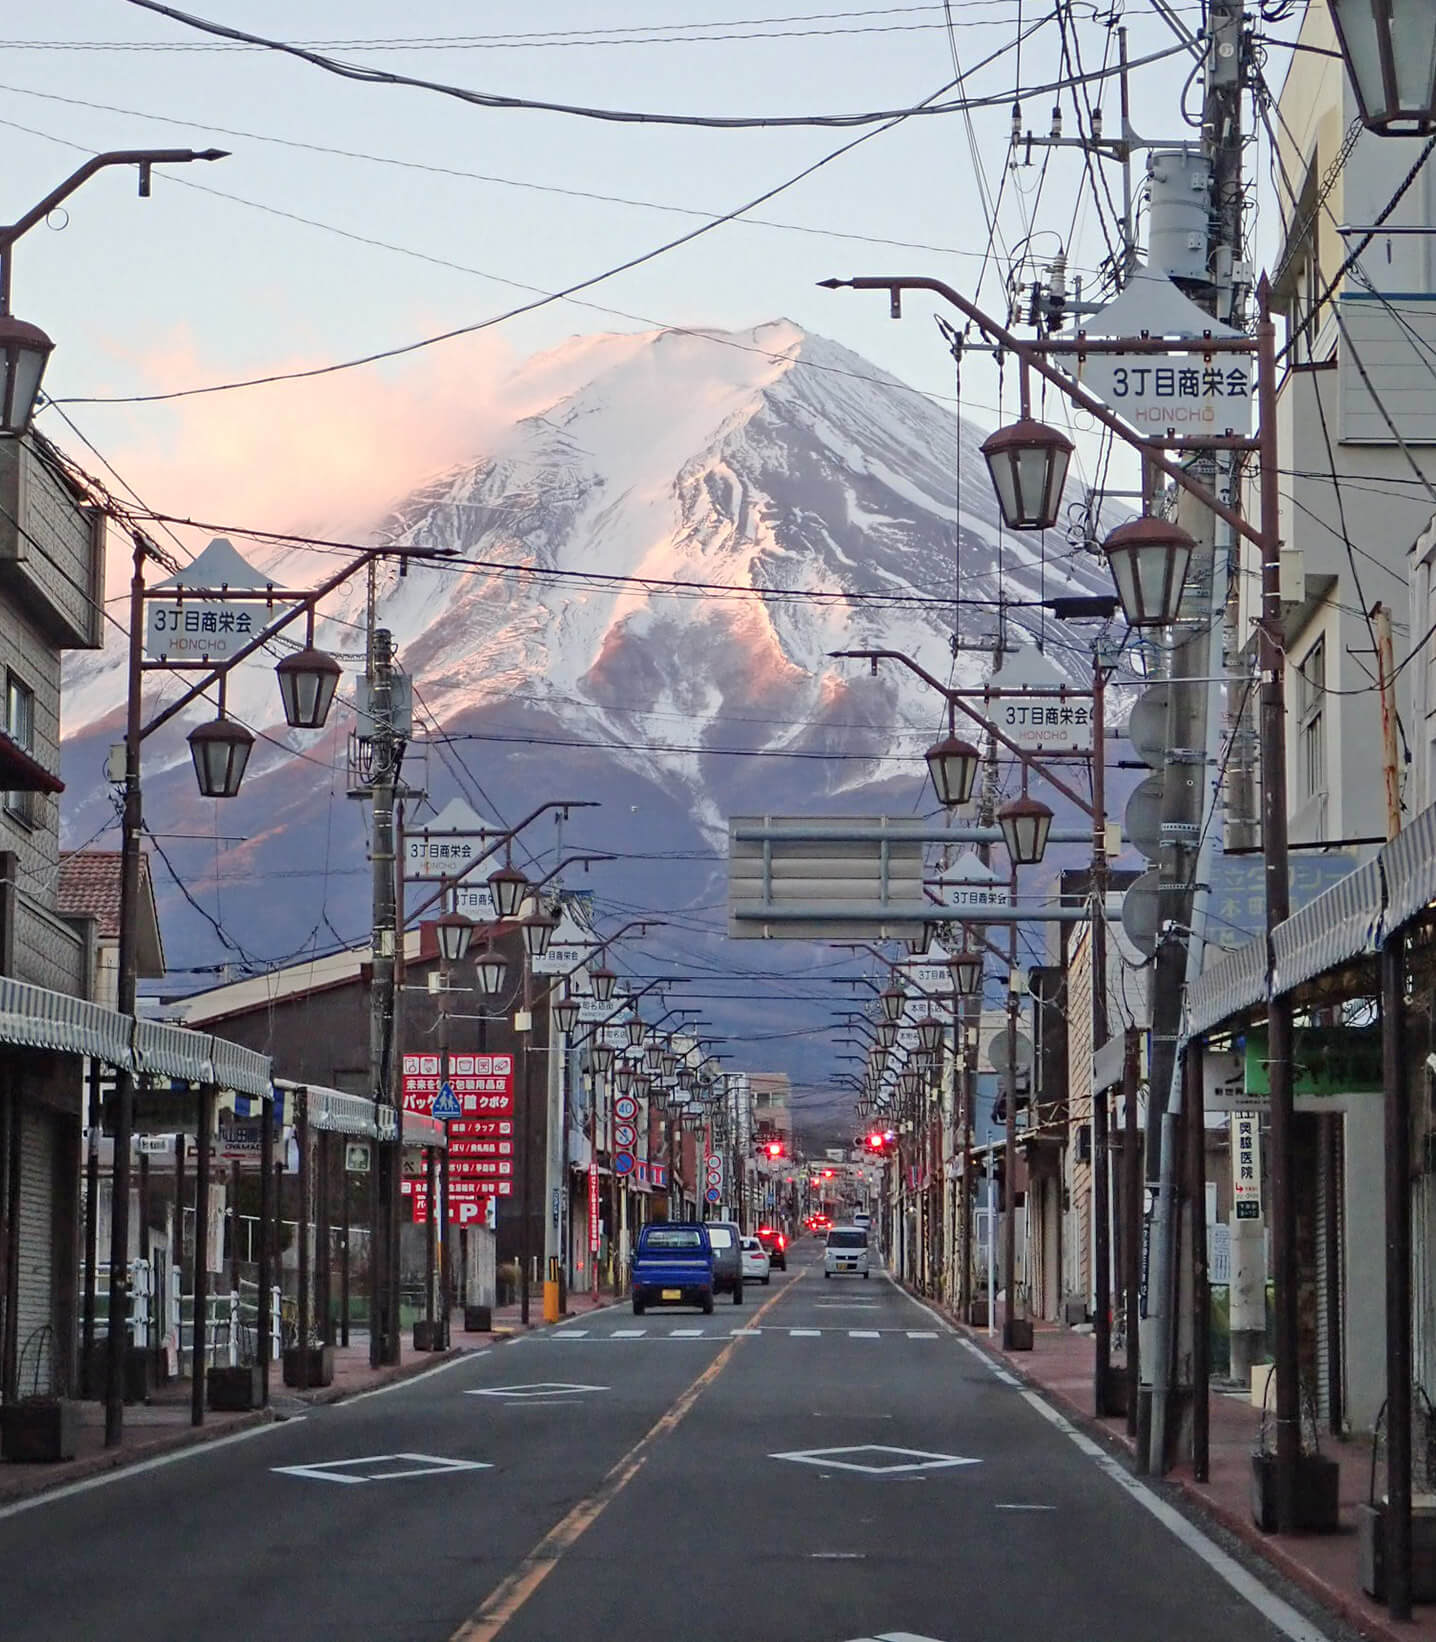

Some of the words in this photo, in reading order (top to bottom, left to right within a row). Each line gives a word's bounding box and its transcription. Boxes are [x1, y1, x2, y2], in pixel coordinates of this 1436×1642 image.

[1112, 367, 1248, 398] 3丁目商栄会
[1135, 407, 1215, 423] HONCHO
[154, 609, 252, 634] 3丁目商栄会
[169, 638, 227, 651] HONCHO
[1005, 706, 1088, 726] 3丁目商栄会
[410, 843, 472, 859] 3丁目商栄会
[952, 890, 1007, 905] 3丁目商栄会
[618, 1103, 633, 1115] 40
[459, 1202, 479, 1223] P
